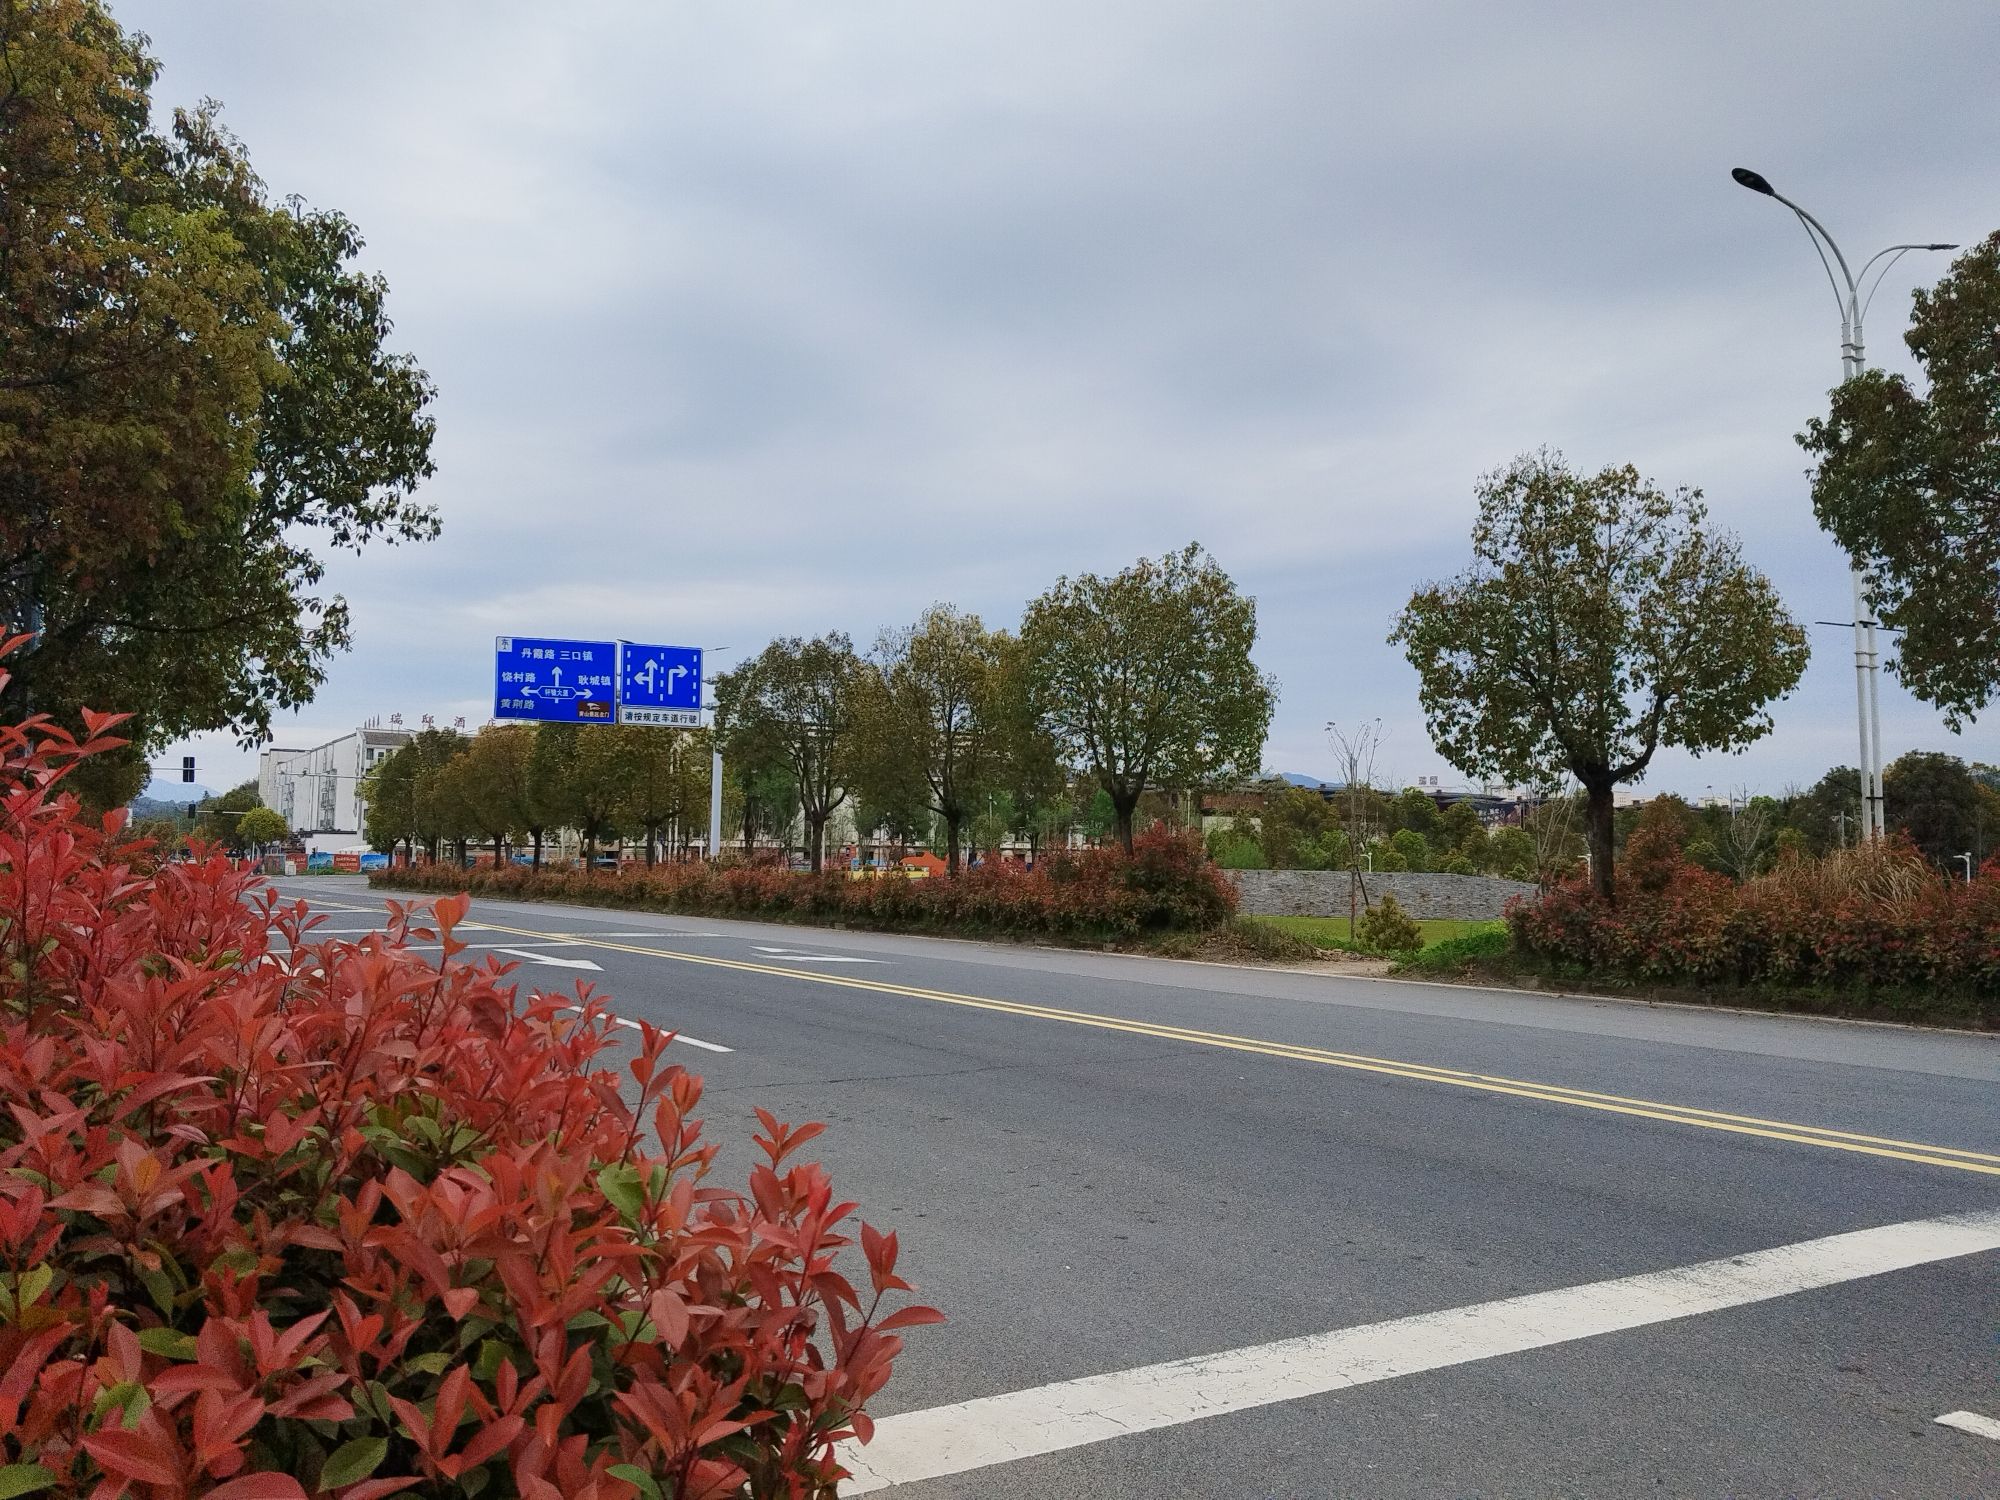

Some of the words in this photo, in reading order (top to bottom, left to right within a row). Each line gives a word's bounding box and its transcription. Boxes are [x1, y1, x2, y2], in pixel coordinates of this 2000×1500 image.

[521, 648, 555, 660] 丹霞路
[560, 650, 593, 661] 三口镇
[578, 675, 611, 686] 耿城镇
[625, 711, 697, 724] 请按规定车道行驶
